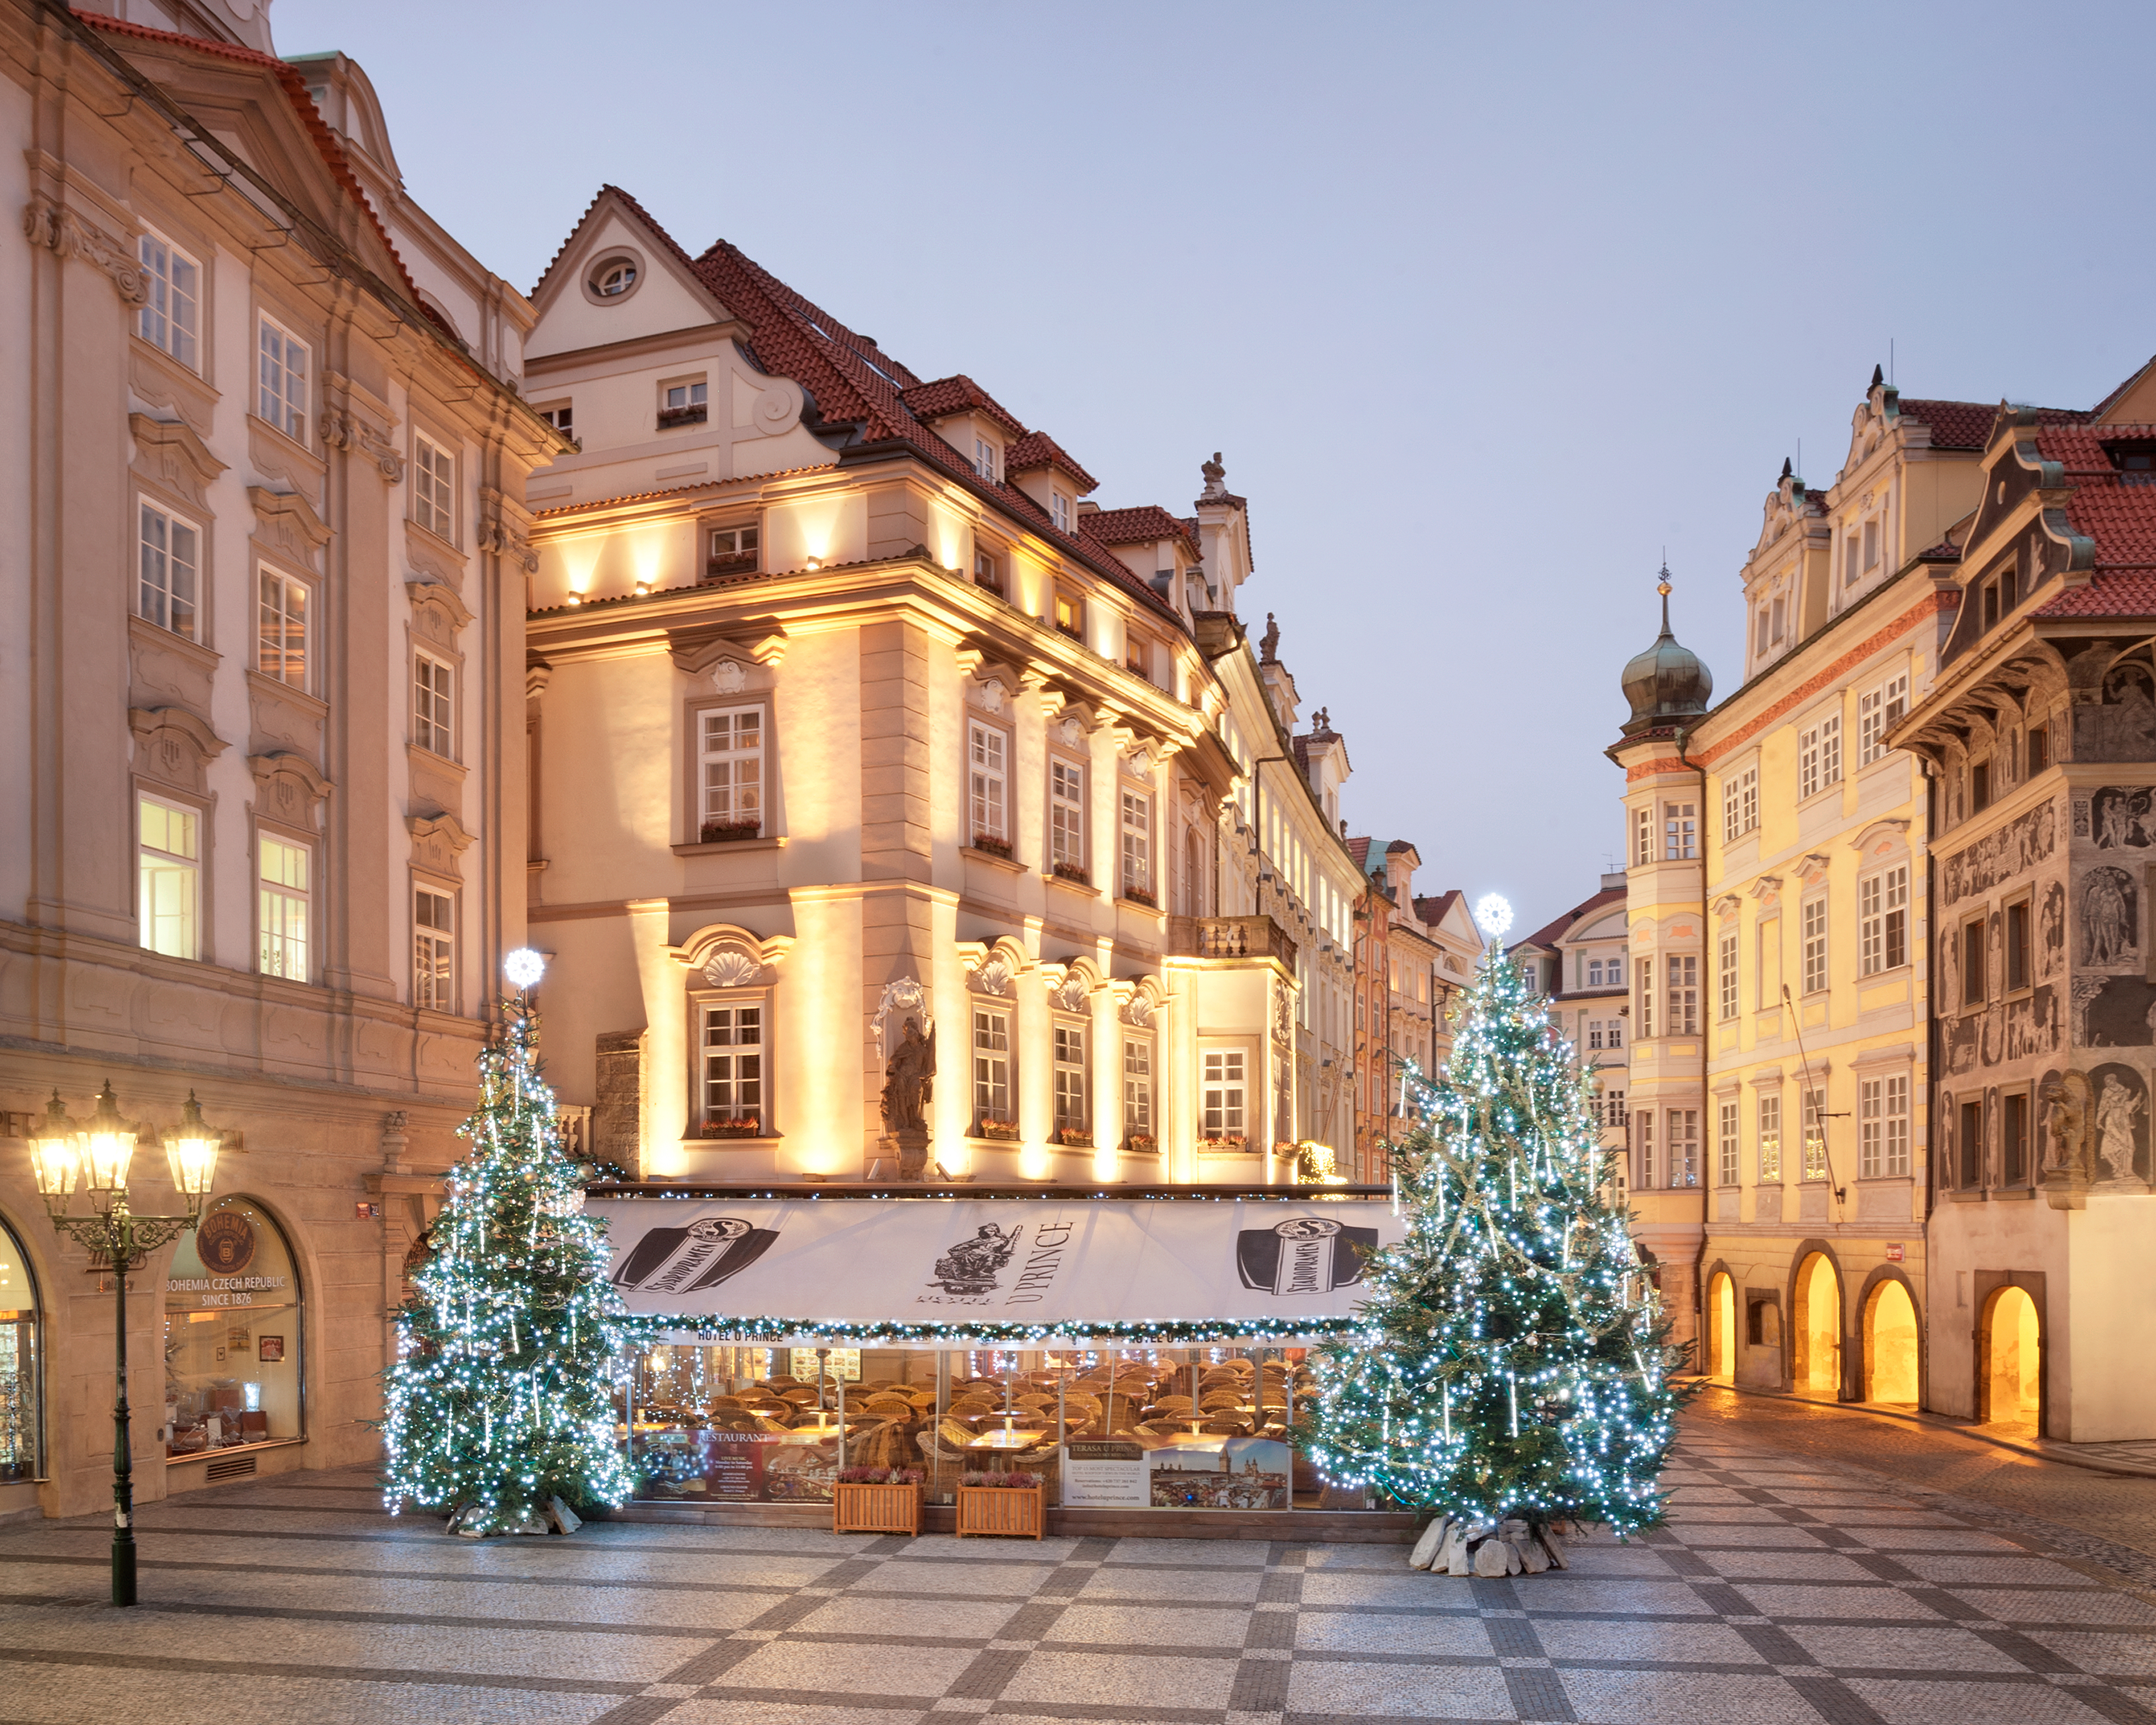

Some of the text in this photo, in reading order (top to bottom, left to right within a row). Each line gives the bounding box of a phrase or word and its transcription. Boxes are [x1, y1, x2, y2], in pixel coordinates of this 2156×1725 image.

[0, 1111, 35, 1137] ET
[203, 1215, 248, 1239] BOHEMIA
[645, 1242, 719, 1290] STAROPRAMEN
[1286, 1242, 1320, 1292] STAROPRAMEN
[166, 1276, 285, 1292] BOHEMIA CZECH REPUBLIC
[202, 1293, 252, 1306] SINCE 1876
[745, 1331, 783, 1342] PRINCE
[698, 1433, 770, 1442] RESTAURANT
